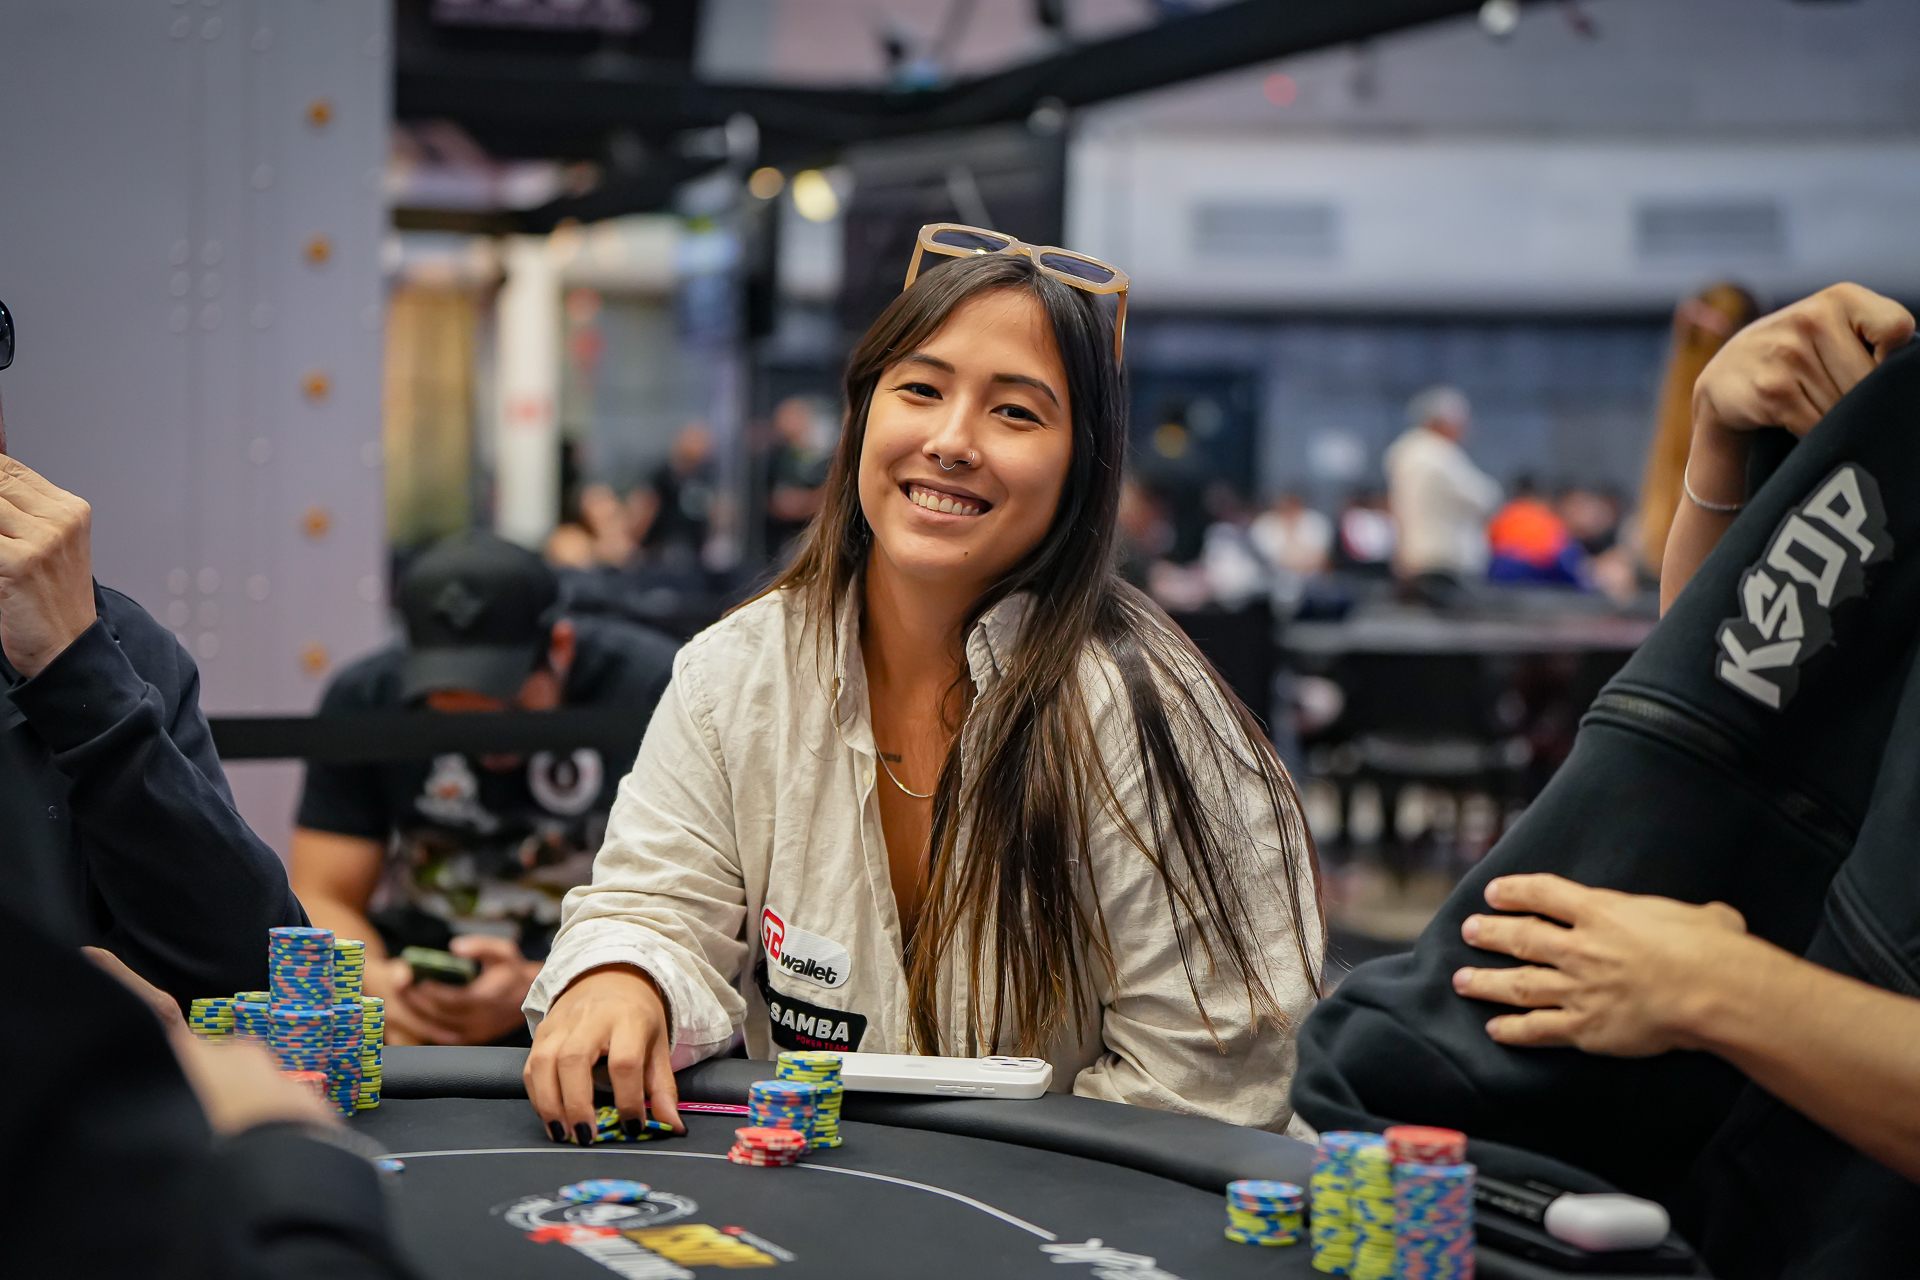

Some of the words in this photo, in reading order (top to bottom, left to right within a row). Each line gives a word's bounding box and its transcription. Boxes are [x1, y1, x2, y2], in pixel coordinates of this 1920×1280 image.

[1720, 466, 1875, 709] KSOP
[780, 951, 838, 985] wallet
[770, 1002, 849, 1042] SAMBA
[795, 1034, 823, 1048] POKER
[824, 1042, 849, 1052] TEAM
